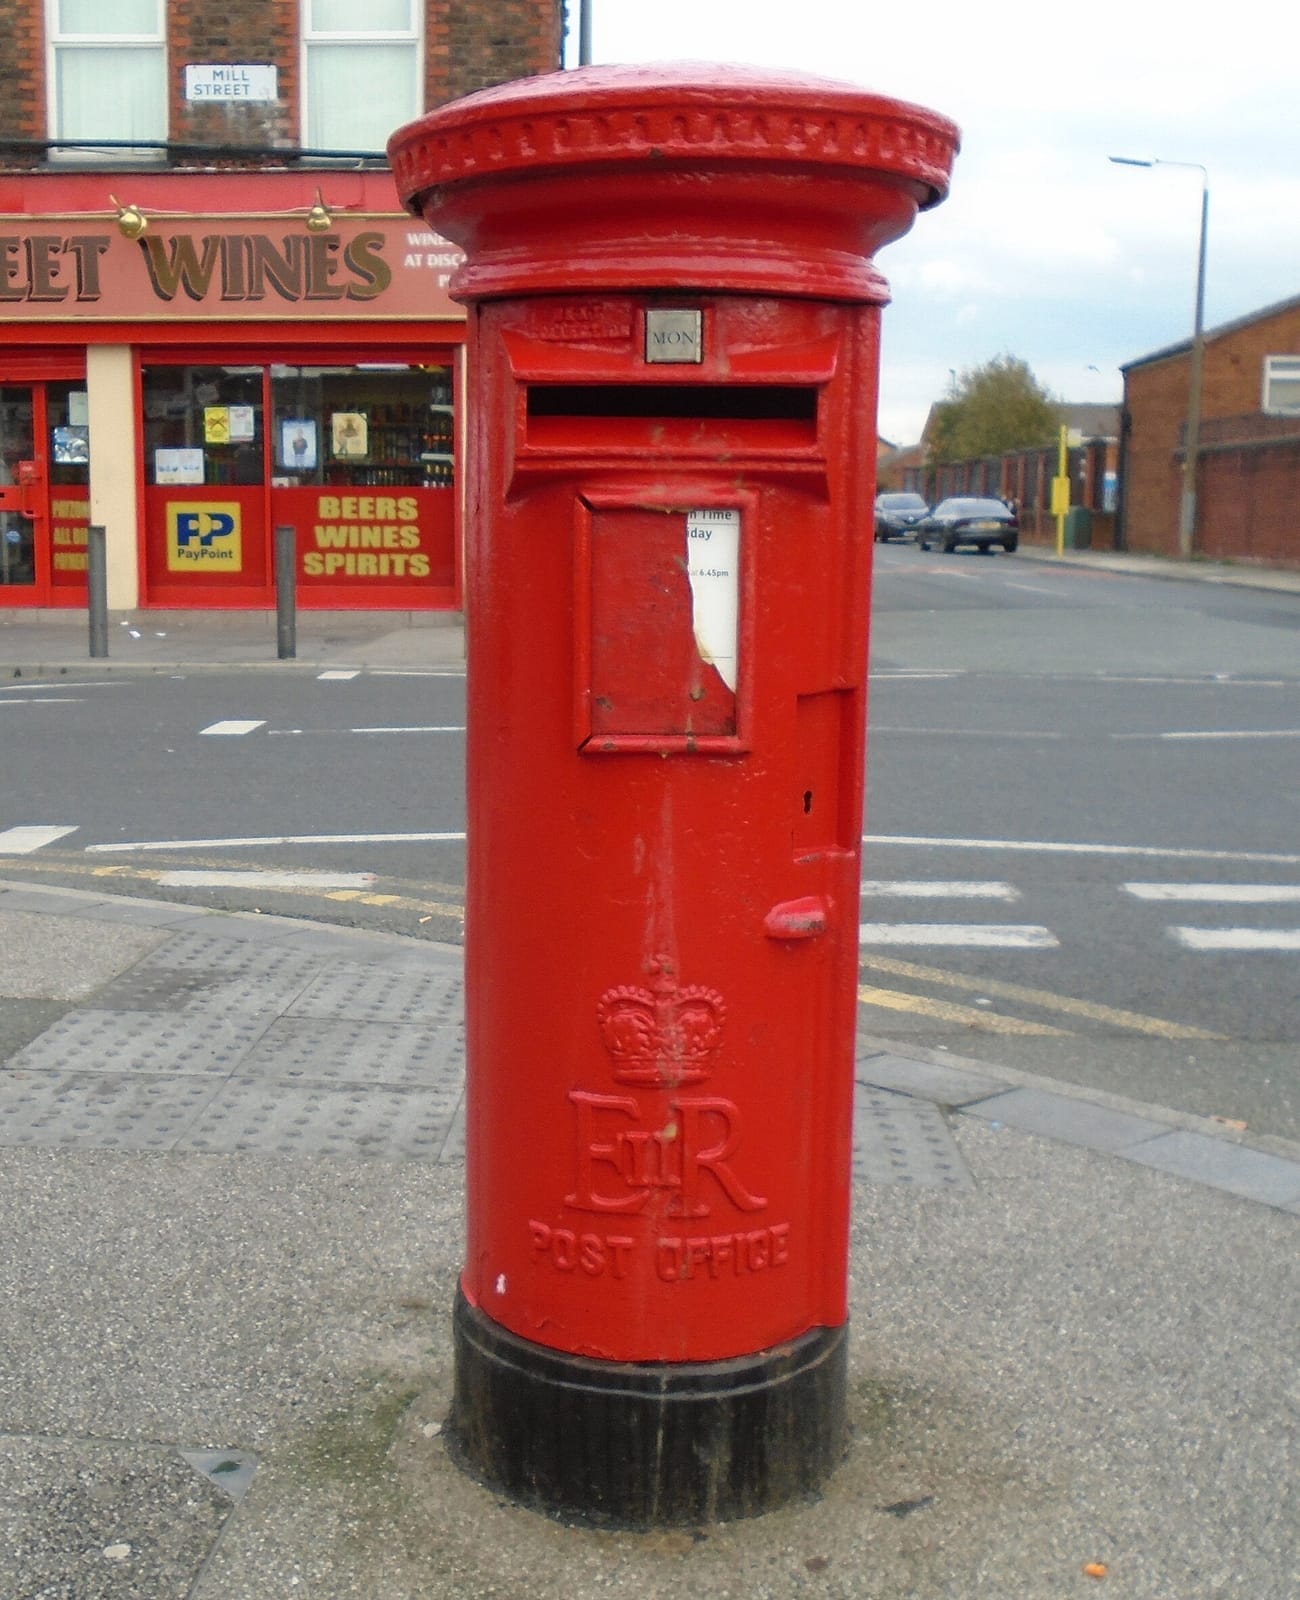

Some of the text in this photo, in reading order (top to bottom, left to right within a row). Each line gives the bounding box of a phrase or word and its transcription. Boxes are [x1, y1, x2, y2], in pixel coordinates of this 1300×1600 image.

[212, 70, 250, 81] MILL
[193, 84, 250, 96] STREET
[137, 231, 392, 302] WINES
[404, 253, 423, 267] AT
[653, 331, 695, 344] MON
[318, 496, 419, 521] BEERS
[314, 525, 421, 549] WINES
[177, 548, 233, 561] PayPoint
[303, 552, 431, 577] SPIRITS
[699, 569, 729, 577] 6.45pm
[528, 1219, 790, 1282] POST OFFICE
